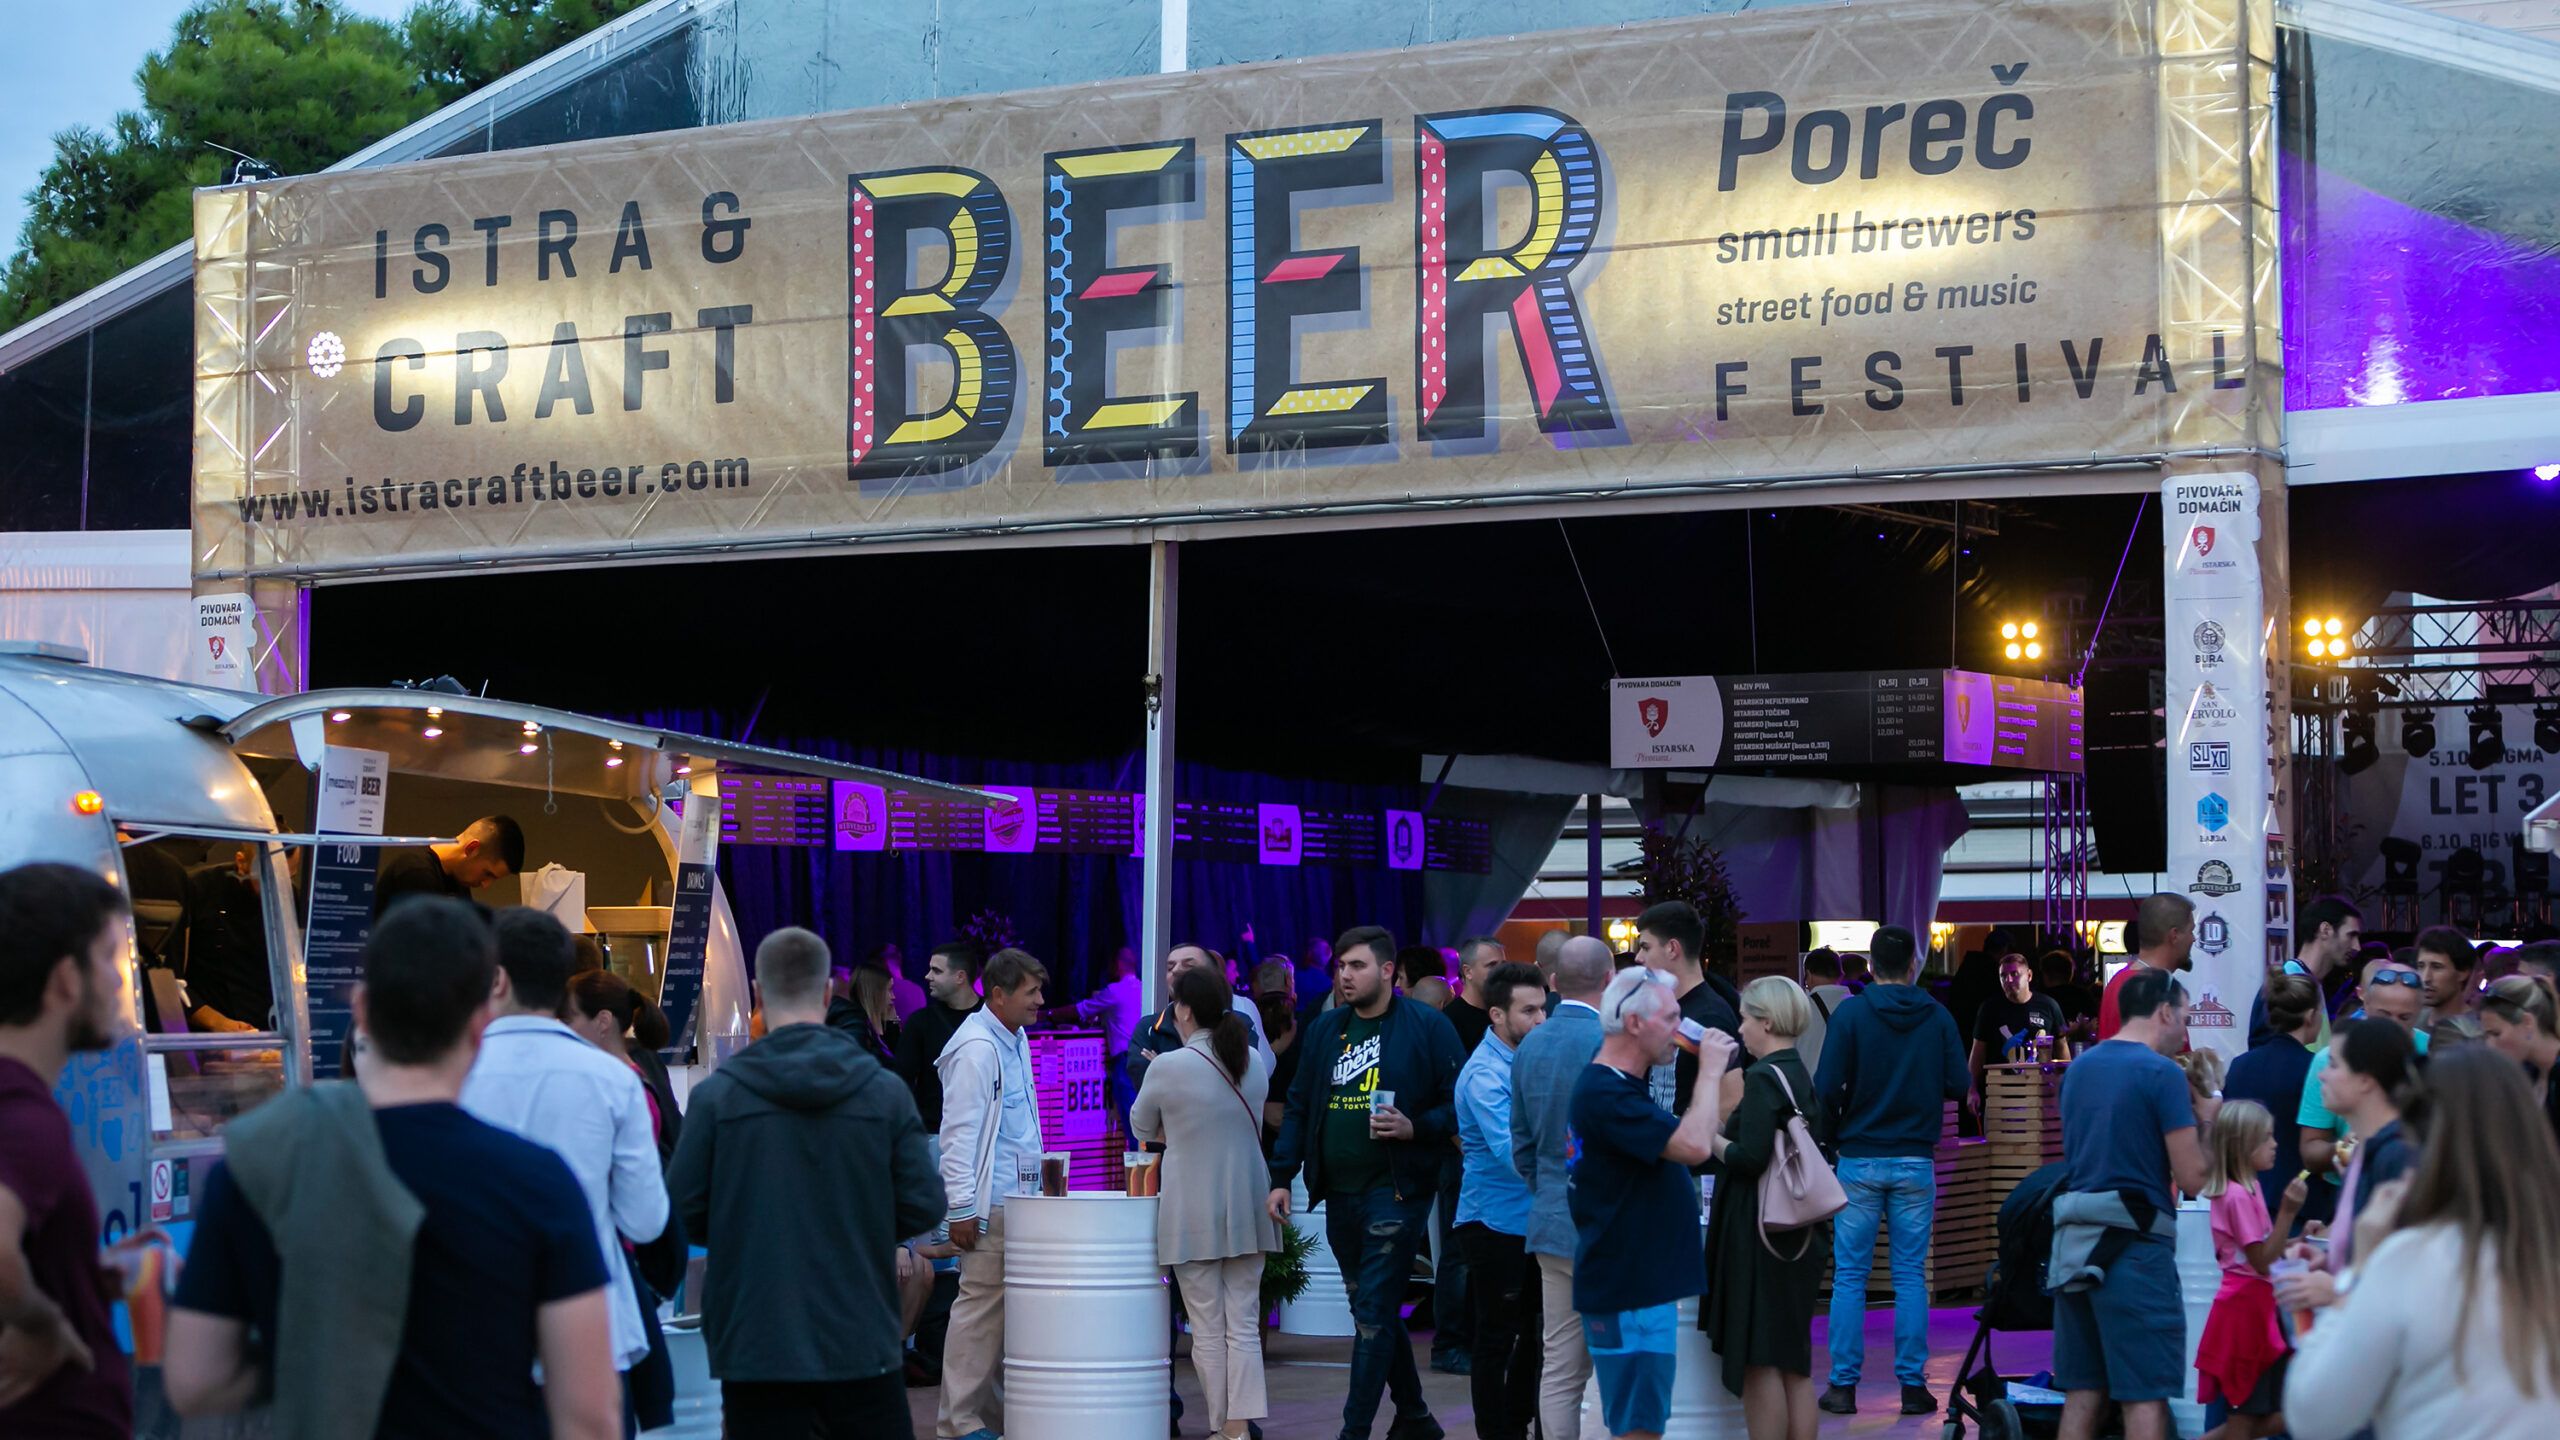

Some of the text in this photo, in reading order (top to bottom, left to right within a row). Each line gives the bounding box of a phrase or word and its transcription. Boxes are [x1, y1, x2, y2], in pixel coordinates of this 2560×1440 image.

[1717, 62, 2035, 192] Poreč
[374, 190, 752, 300] ISTRA &
[1716, 207, 2037, 265] small brewers
[847, 104, 1617, 482] BEER
[1716, 273, 2038, 326] street food & music
[371, 304, 754, 433] CRAFT
[1715, 329, 2247, 423] FESTIVAL
[236, 453, 751, 524] www.istracraftbeer.com
[2176, 485, 2244, 499] PIVOVARA
[200, 603, 242, 614] PIVOVARA
[2194, 654, 2225, 664] BURA
[1617, 681, 1650, 689] PIVOVARA
[1754, 682, 1770, 690] PIVA
[2186, 708, 2237, 719] ERVOLO
[1651, 744, 1695, 754] ISTARSKA
[361, 776, 381, 796] BEER
[2430, 773, 2545, 815] LET 3
[336, 845, 361, 864] FOOD
[686, 871, 706, 890] DRINKS
[1066, 1058, 1098, 1073] CRAFT
